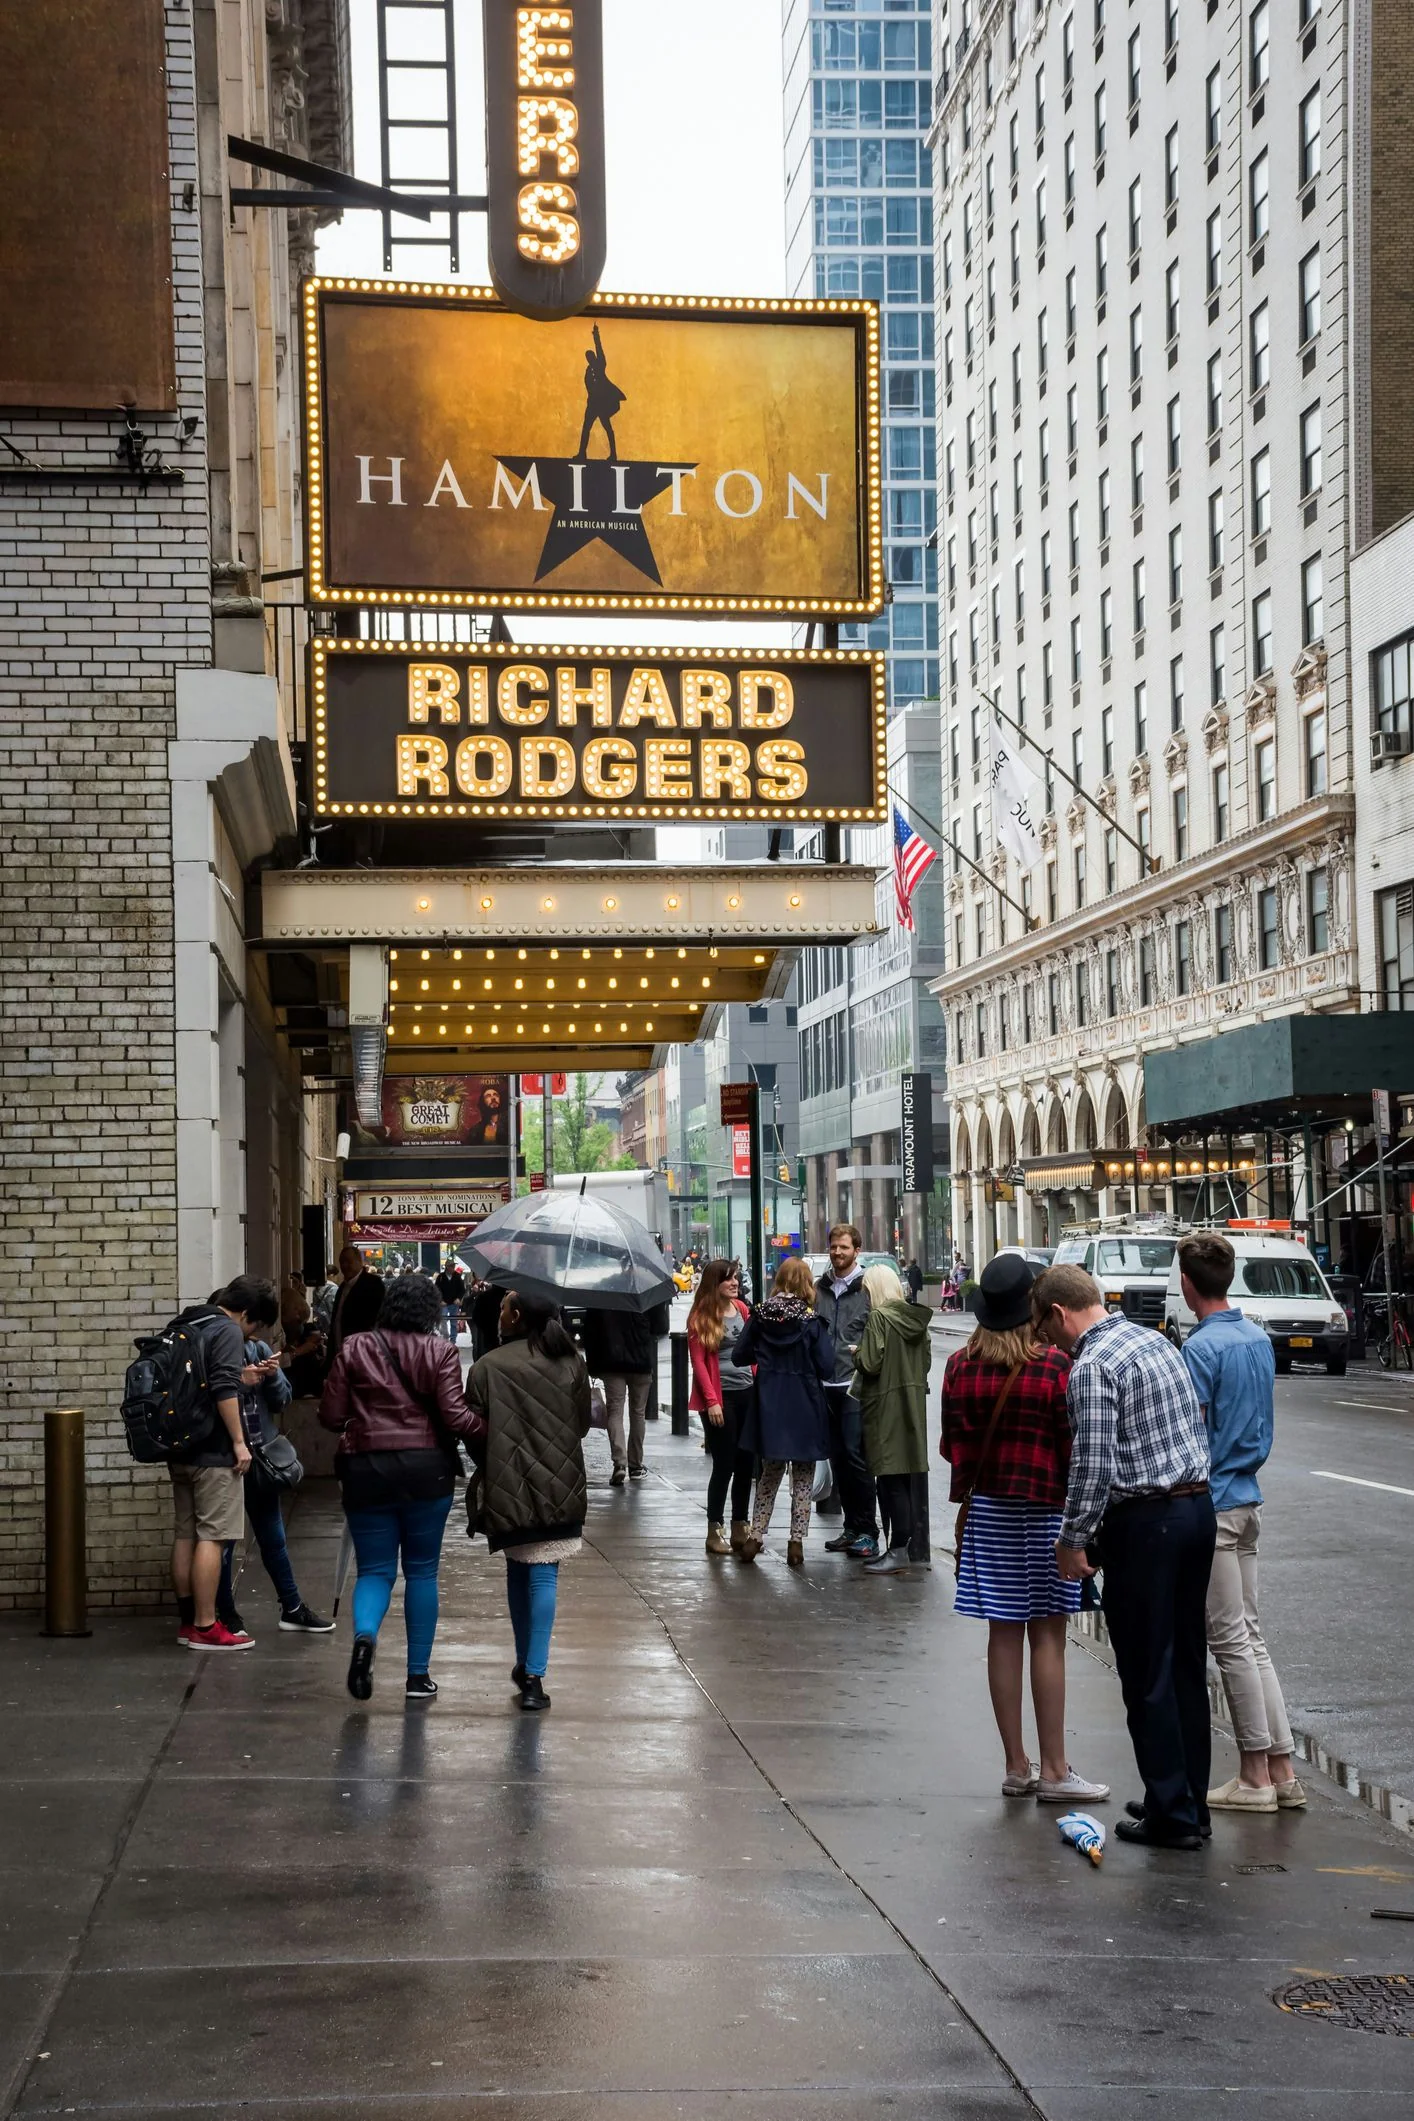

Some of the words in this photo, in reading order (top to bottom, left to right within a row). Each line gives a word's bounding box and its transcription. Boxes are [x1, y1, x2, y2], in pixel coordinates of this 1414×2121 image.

[517, 0, 580, 263] ERS
[354, 454, 831, 521] HAMILTON
[557, 520, 566, 528] AN
[569, 520, 605, 530] AMERICAN
[608, 522, 638, 531] MUSICAL
[408, 663, 795, 729] RICHARD
[396, 734, 808, 800] RODGERS
[903, 1075, 914, 1114] HOTEL
[410, 1114, 450, 1125] COMET
[411, 1105, 449, 1116] GREAT
[904, 1117, 915, 1191] PARAMOUNT
[369, 1195, 394, 1216] 12
[398, 1204, 432, 1215] BEST
[435, 1202, 497, 1214] MUSICAL
[447, 1193, 497, 1201] NOMINATIONS
